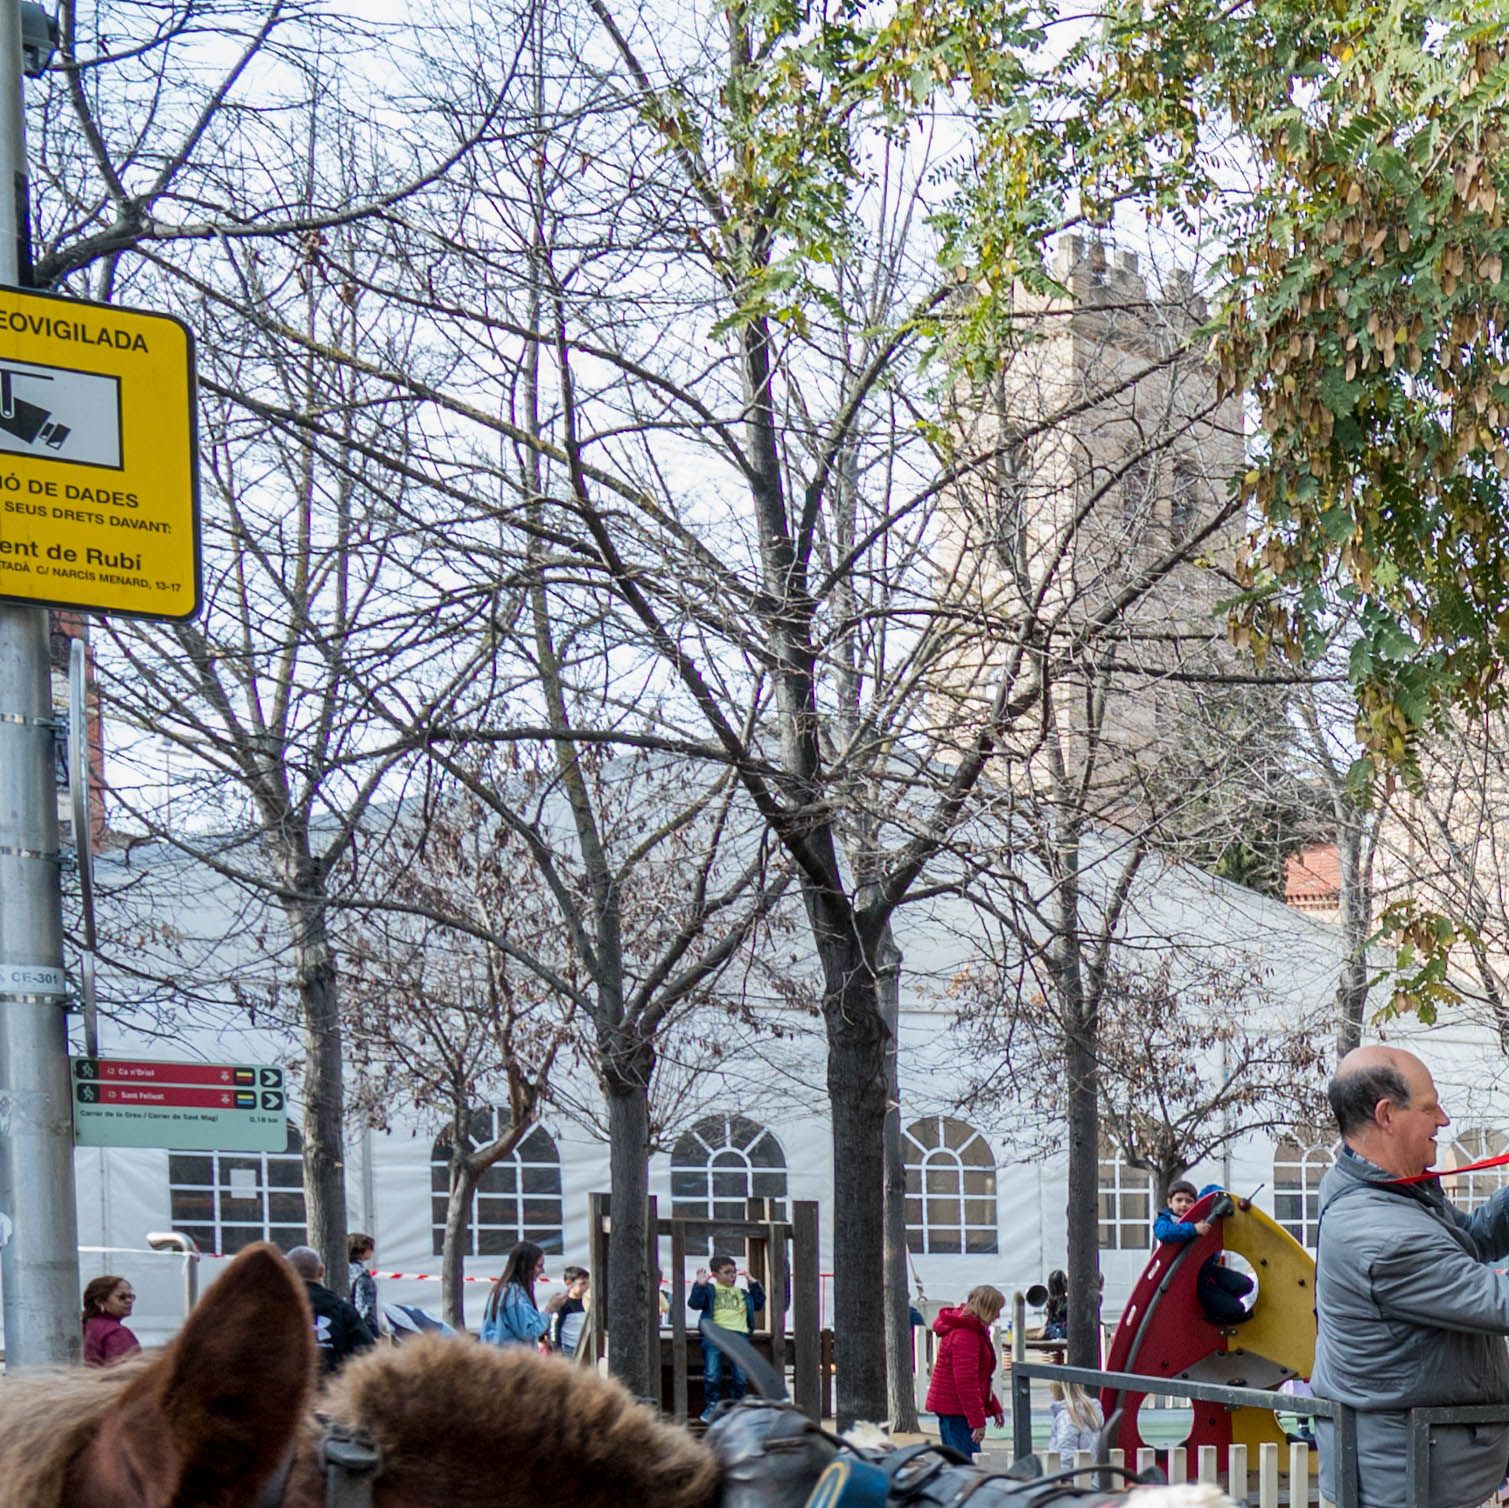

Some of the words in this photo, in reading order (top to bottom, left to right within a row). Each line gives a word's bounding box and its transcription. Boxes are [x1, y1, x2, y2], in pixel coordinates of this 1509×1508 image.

[28, 479, 58, 497] DE
[65, 484, 139, 509] DADES
[4, 500, 48, 517] SEUS
[52, 507, 104, 525] DRETS
[109, 515, 173, 534] DAVANT:
[46, 543, 78, 562] de
[86, 547, 143, 571] Rubí
[36, 565, 49, 575] C/
[53, 567, 96, 581] NARCÍS
[99, 573, 152, 590] MENARD,
[155, 581, 181, 592] 13-17
